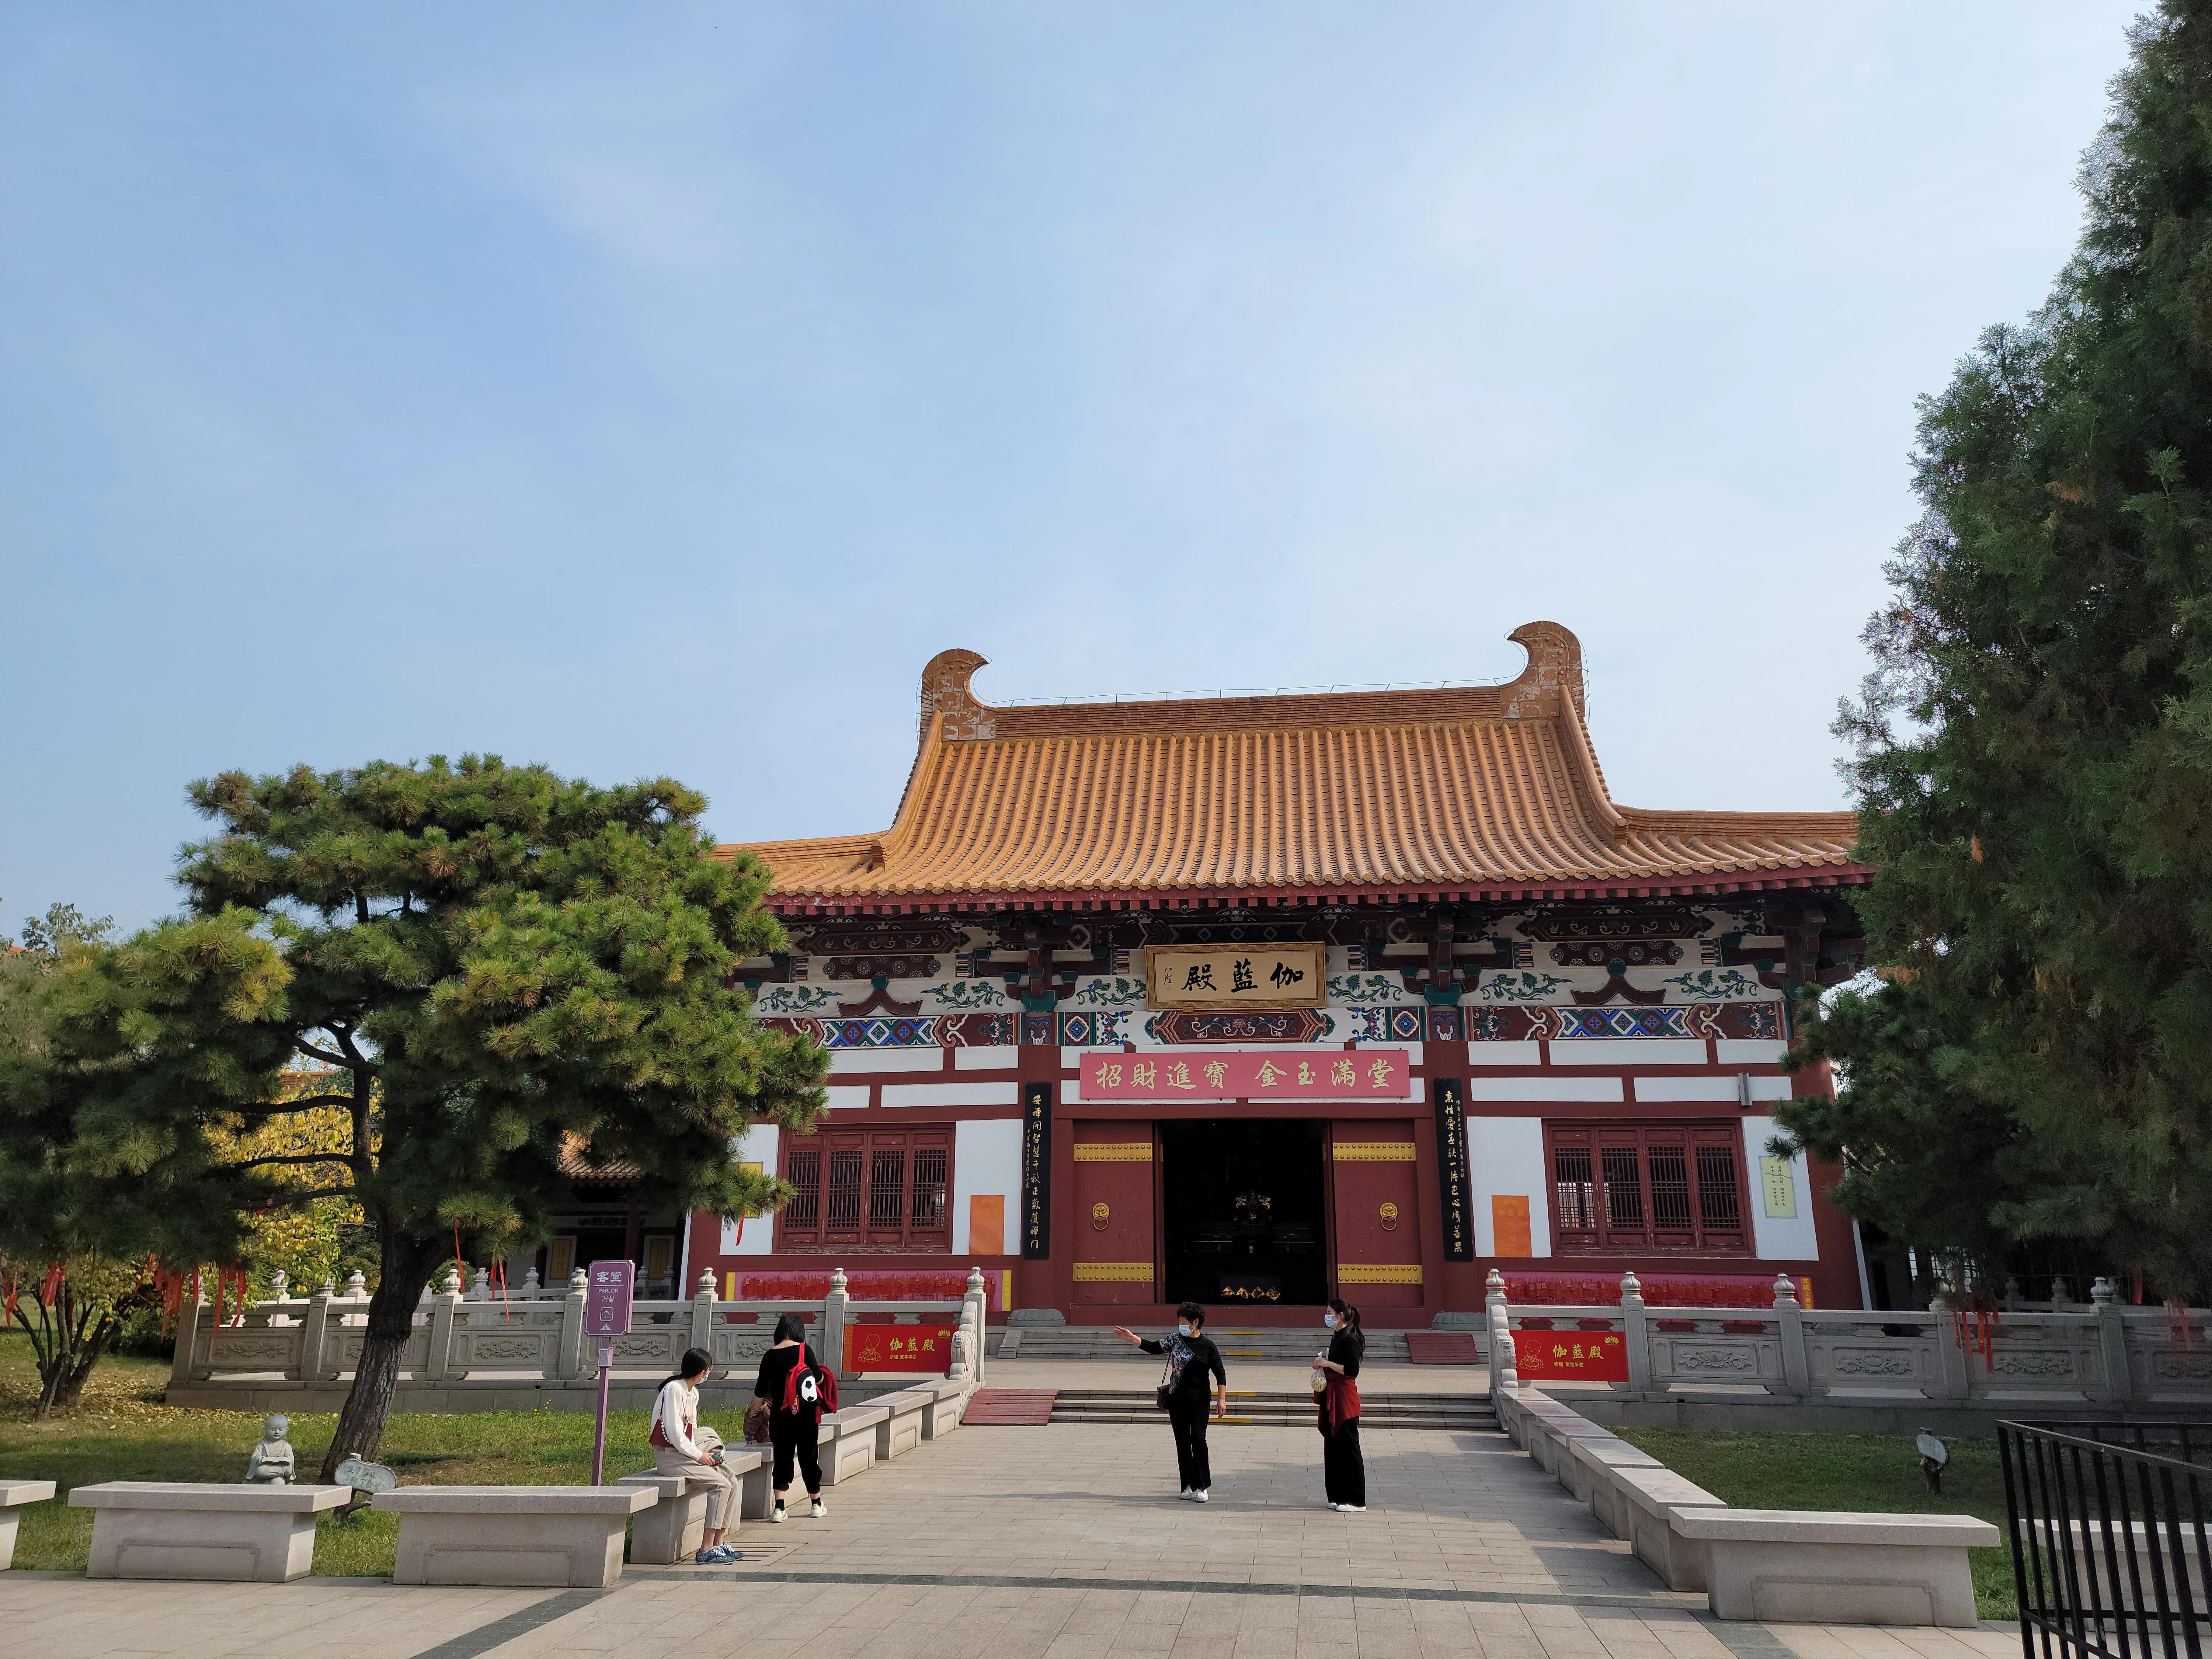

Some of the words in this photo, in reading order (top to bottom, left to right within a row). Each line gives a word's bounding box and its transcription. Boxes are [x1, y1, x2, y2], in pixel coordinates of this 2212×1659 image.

[1181, 958, 1304, 993] 伽藍殿
[1096, 1061, 1229, 1090] 招財進寶
[1255, 1058, 1395, 1088] 金玉滿堂
[597, 1271, 622, 1283] 客堂
[890, 1337, 936, 1352] 伽藍殿
[1552, 1343, 1604, 1359] 伽藍殿
